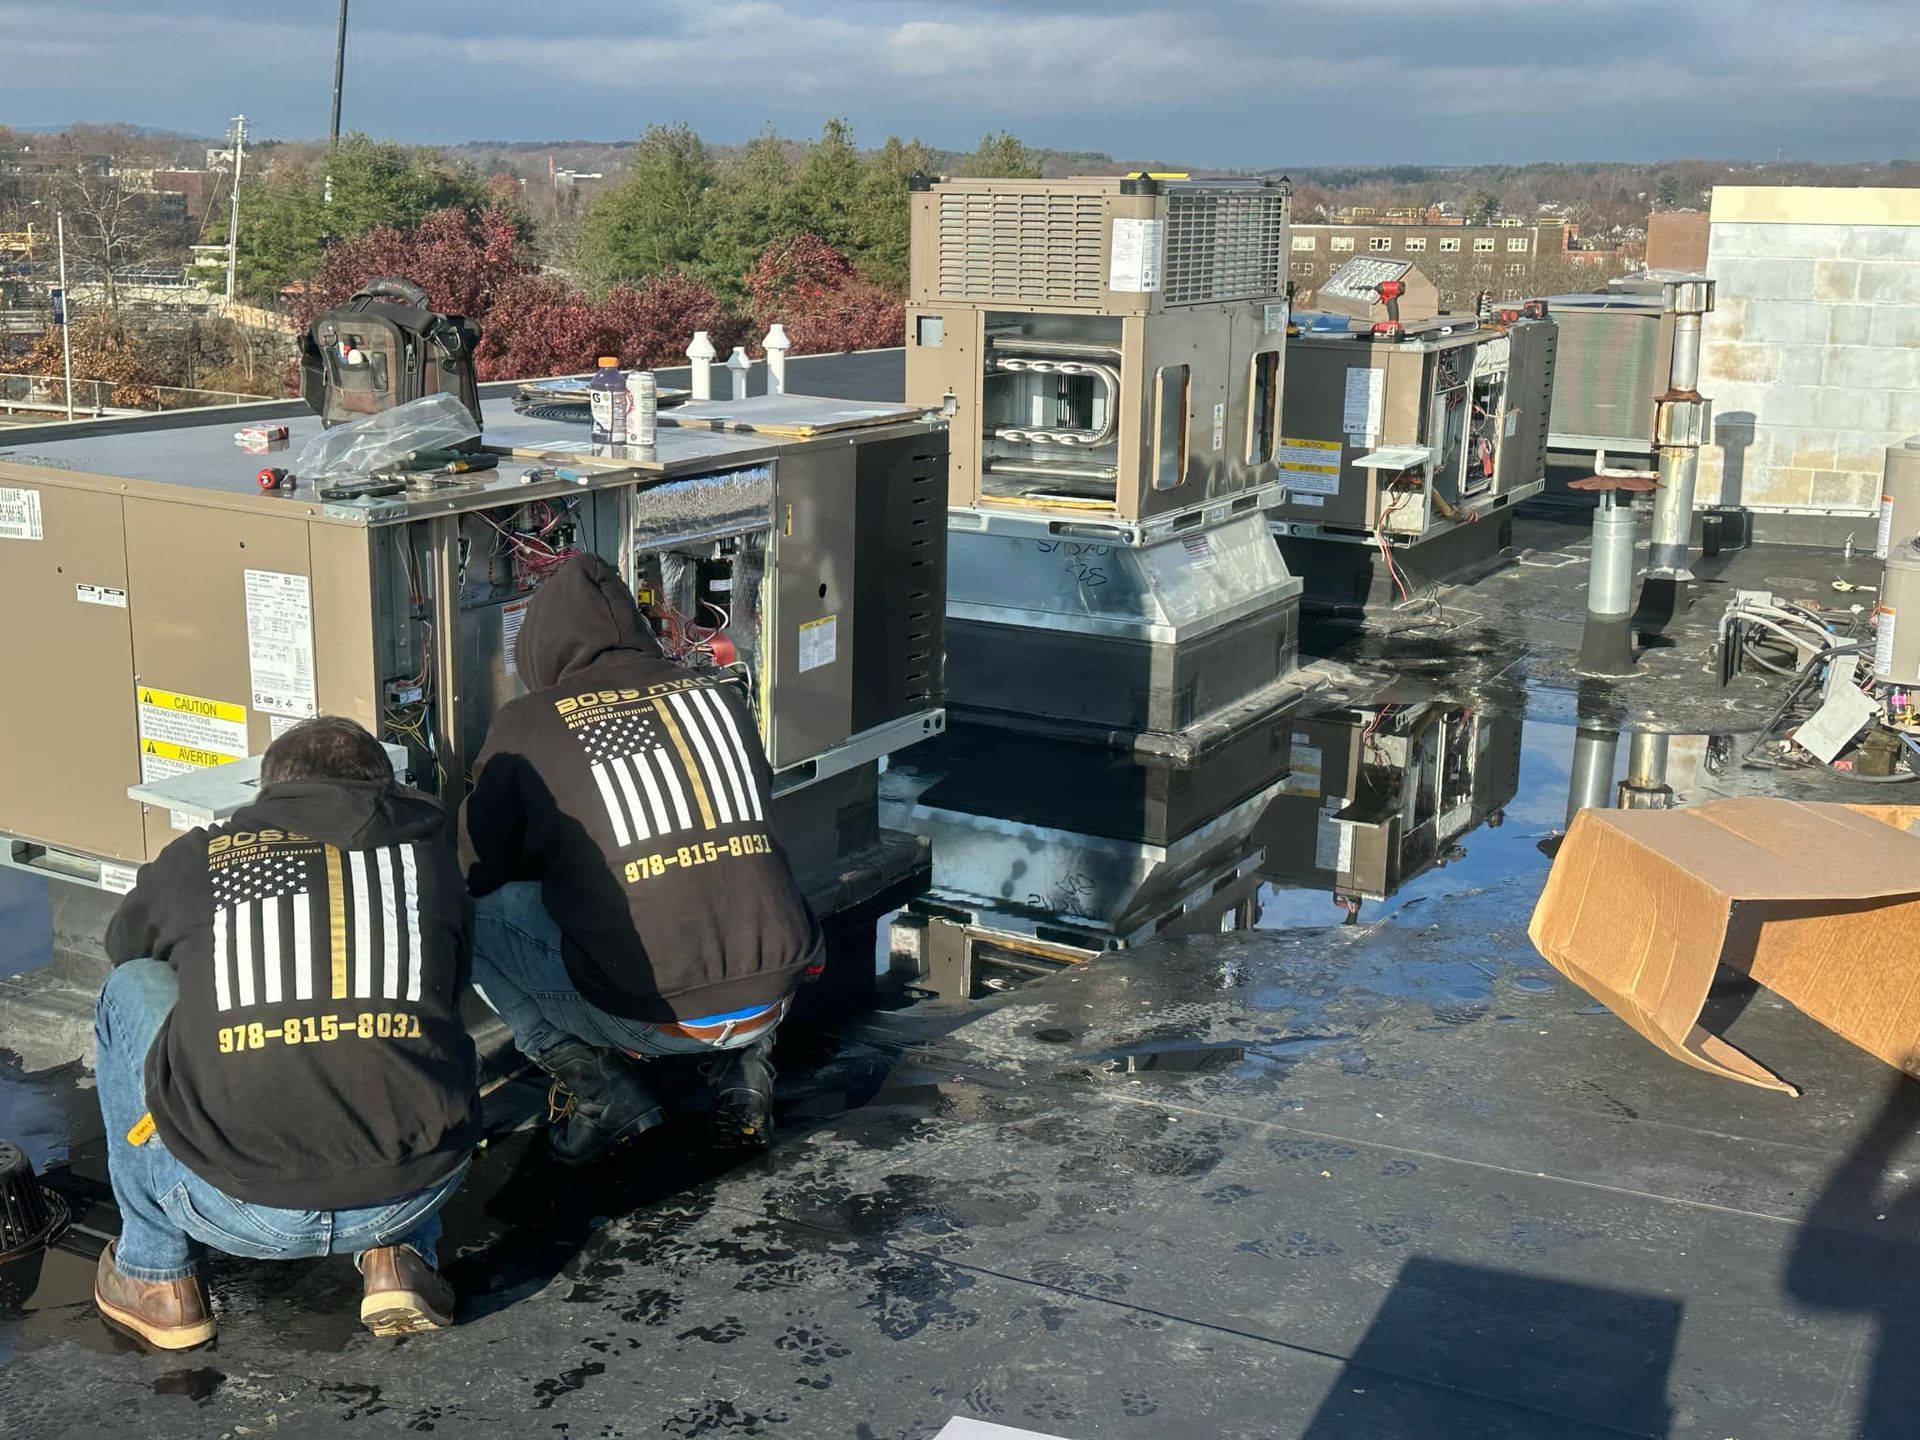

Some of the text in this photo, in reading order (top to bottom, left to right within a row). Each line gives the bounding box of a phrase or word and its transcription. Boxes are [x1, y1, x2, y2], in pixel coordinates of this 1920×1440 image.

[174, 697, 217, 716] CAUTION
[554, 688, 640, 715] BOSS
[565, 707, 606, 723] HEATING
[568, 705, 654, 730] AIR CONDITIONING
[178, 748, 219, 766] AVERTIR
[208, 848, 322, 872] AIR CONDITIONING
[209, 848, 258, 864] HEATING
[624, 834, 772, 883] 978-815-8031
[219, 1013, 422, 1053] 978-815-8031
